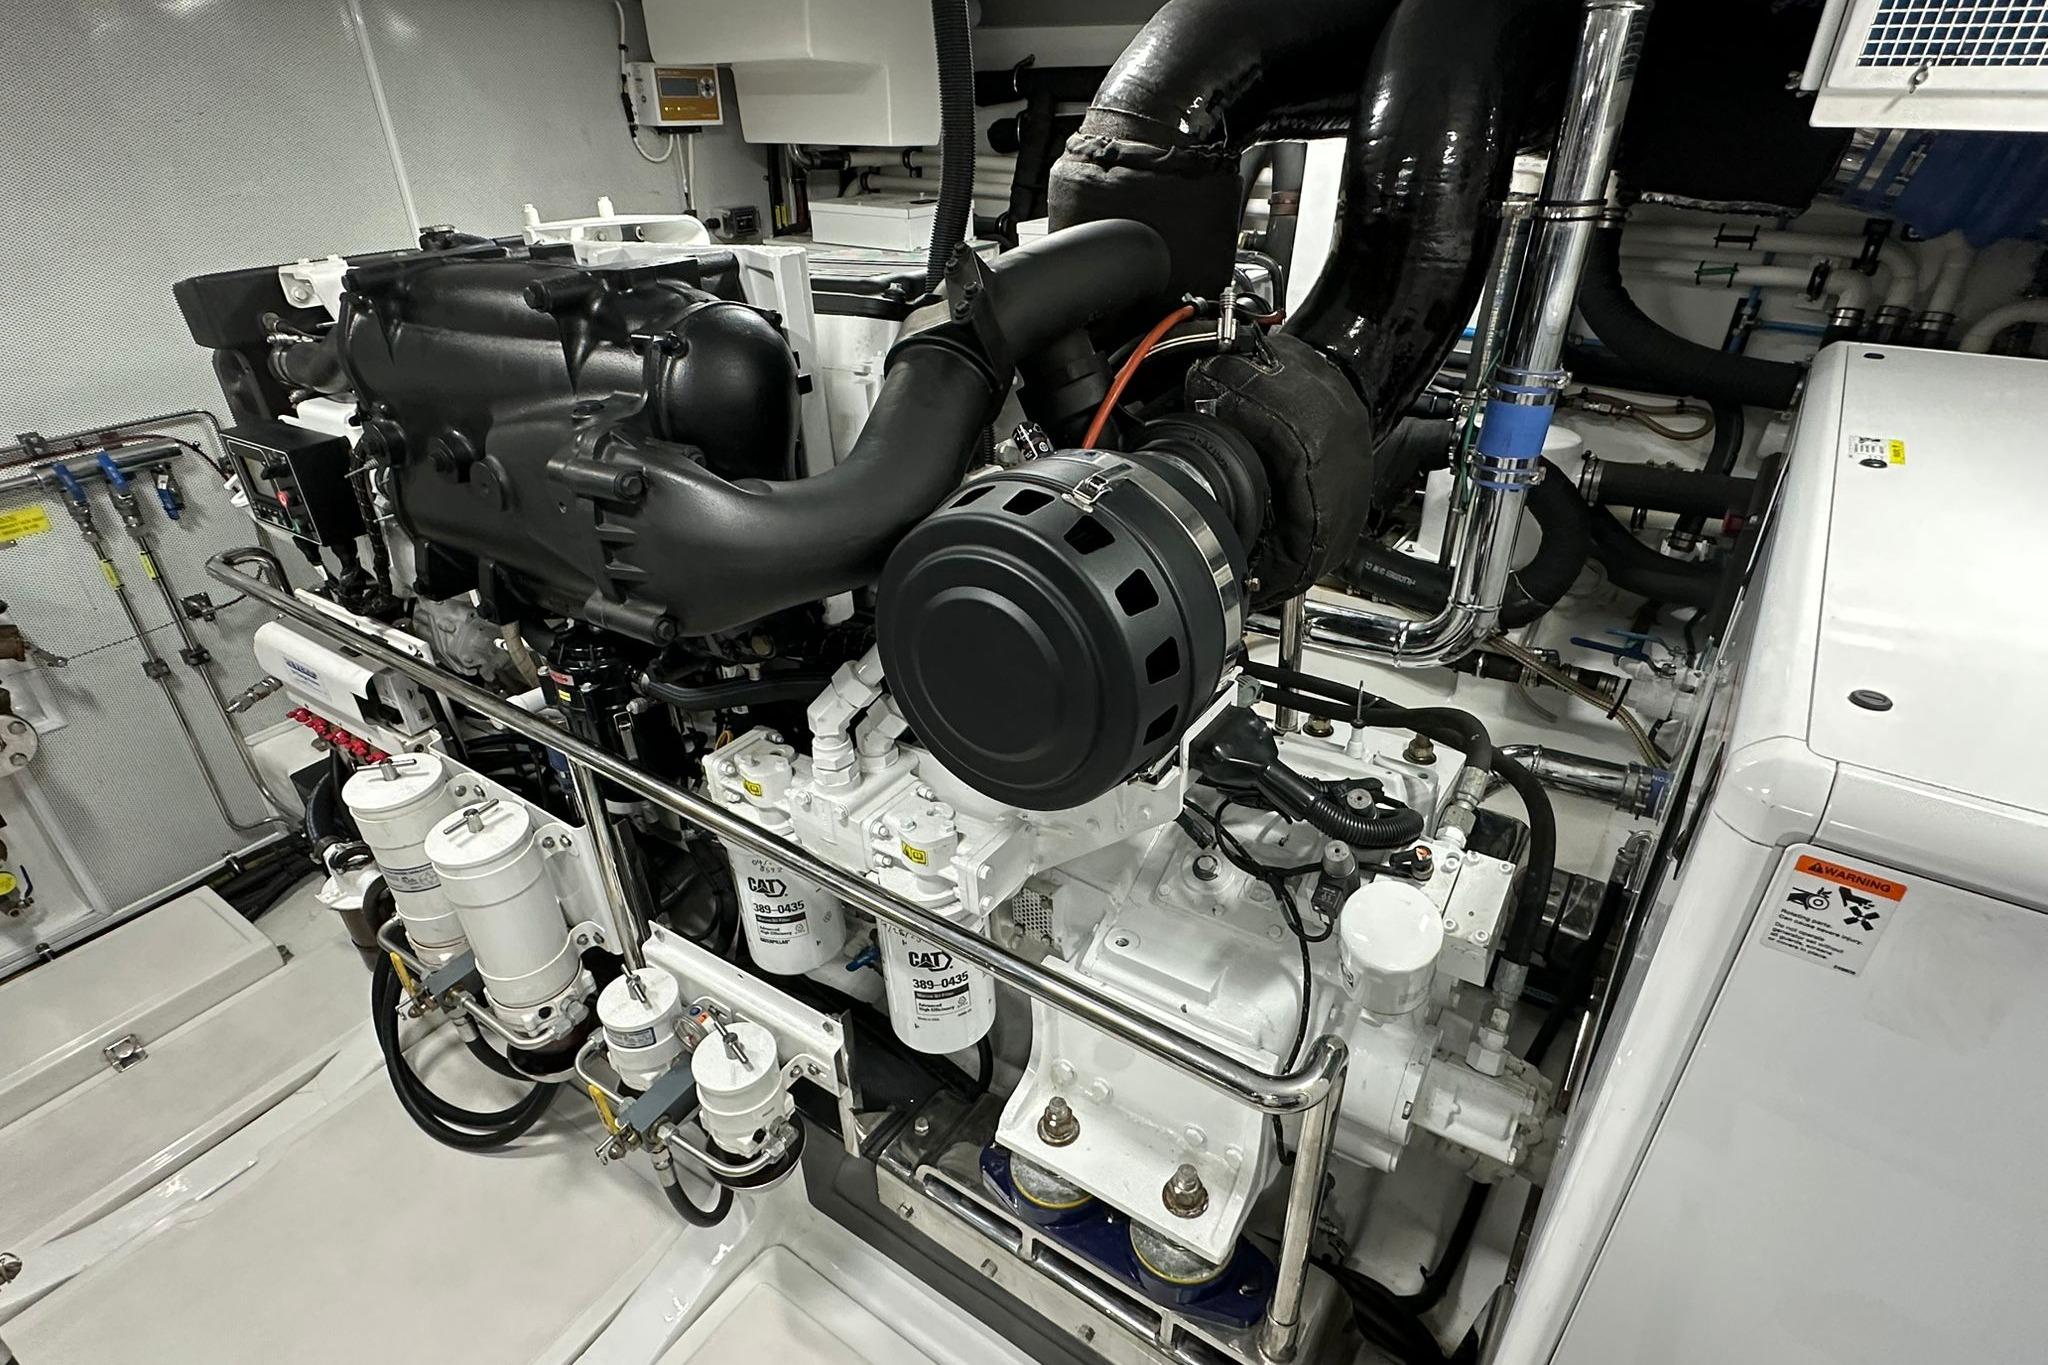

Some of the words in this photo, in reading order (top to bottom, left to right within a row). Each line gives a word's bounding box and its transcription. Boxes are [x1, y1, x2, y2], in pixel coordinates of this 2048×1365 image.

[747, 877, 781, 895] CAT
[1825, 865, 1892, 893] WARNING
[753, 900, 805, 914] 389-0435
[1780, 908, 1811, 922] Rotating
[1778, 913, 1793, 922] Can
[1793, 919, 1816, 929] cause
[1816, 927, 1840, 938] severe
[1841, 934, 1863, 946] injury.
[1798, 930, 1825, 942] operate
[1772, 927, 1804, 940] generator
[1818, 942, 1844, 954] without
[1776, 939, 1799, 950] covers
[908, 951, 944, 968] CAT
[912, 970, 969, 989] 389-0435
